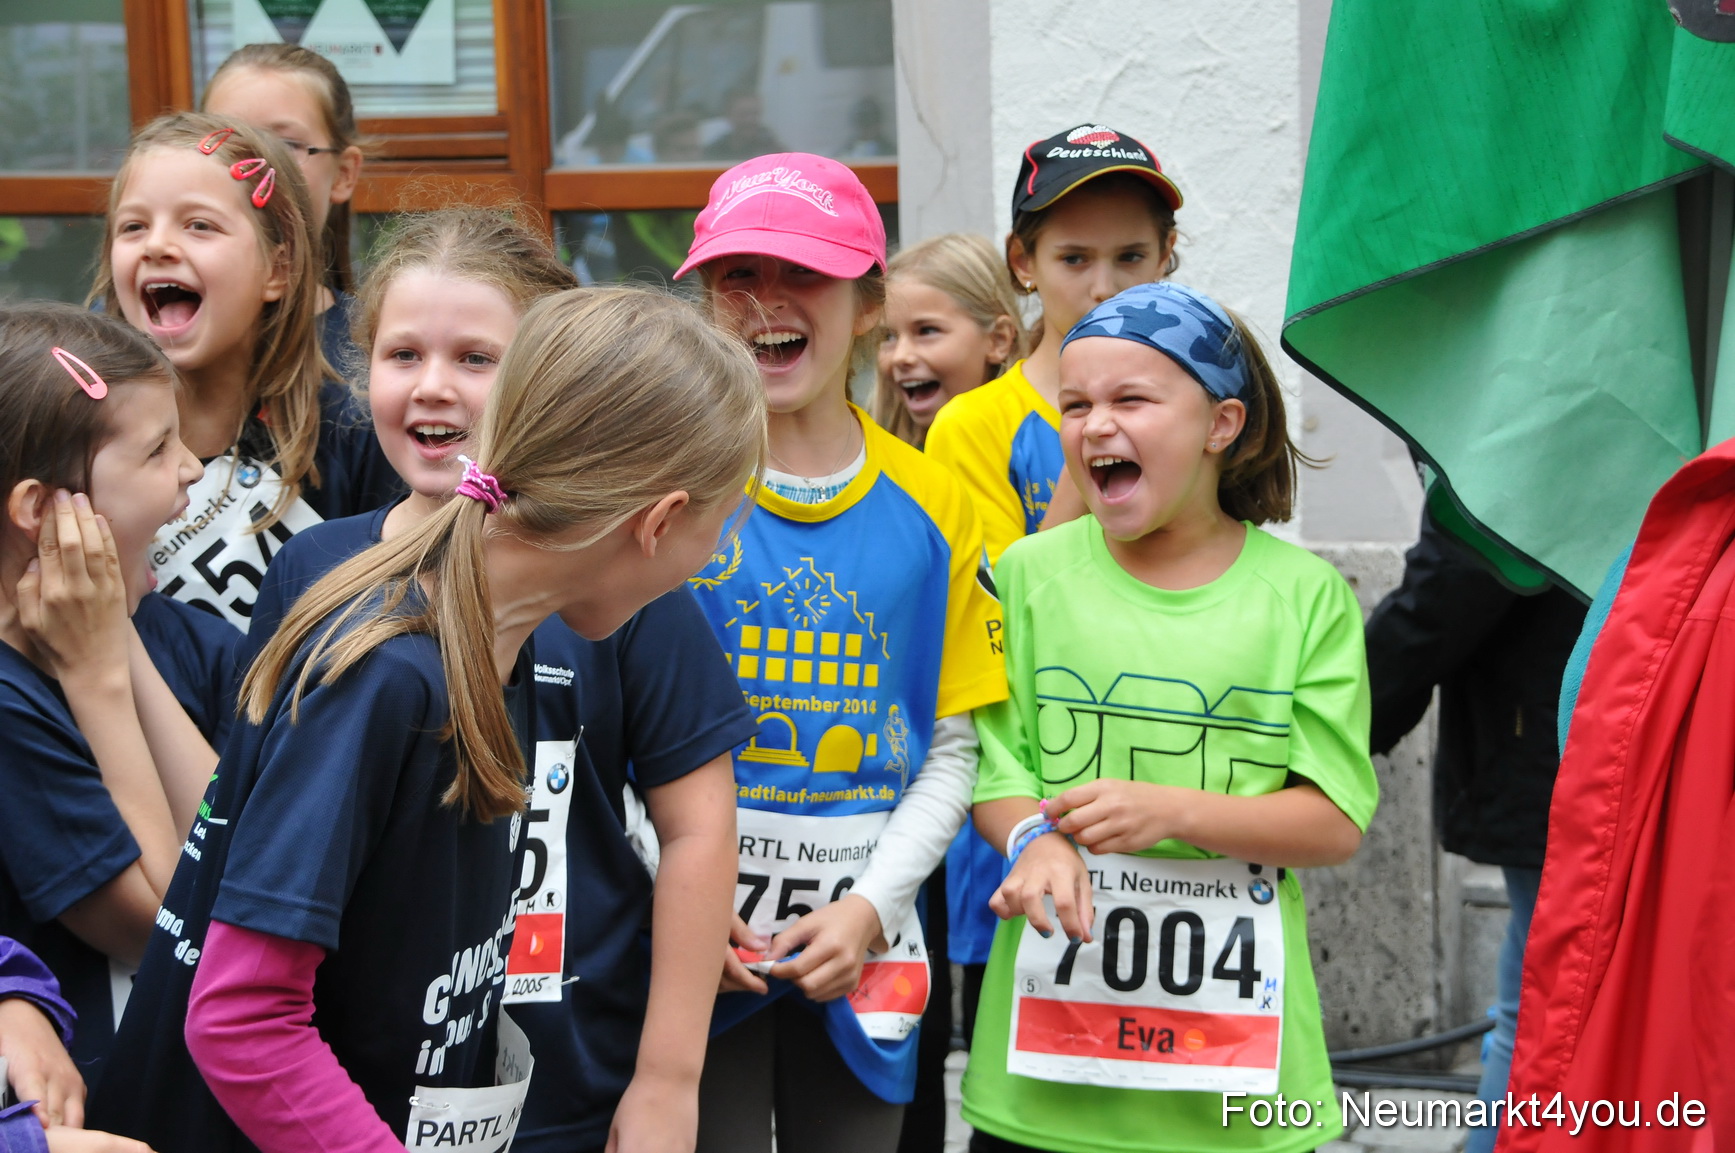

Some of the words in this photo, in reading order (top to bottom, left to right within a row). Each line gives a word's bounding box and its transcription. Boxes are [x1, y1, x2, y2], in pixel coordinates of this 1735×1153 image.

[1046, 147, 1148, 162] Deutschland
[770, 166, 834, 211] York
[149, 489, 238, 572] eumarkt
[842, 698, 877, 715] 2014
[734, 782, 896, 804] tadtlauf-neumarkt.de
[738, 834, 790, 861] RTL
[1120, 871, 1238, 899] Neumarkt
[511, 976, 551, 996] 2005
[1027, 978, 1036, 993] 5
[1117, 1017, 1175, 1054] Eva
[415, 1113, 503, 1148] PARTL
